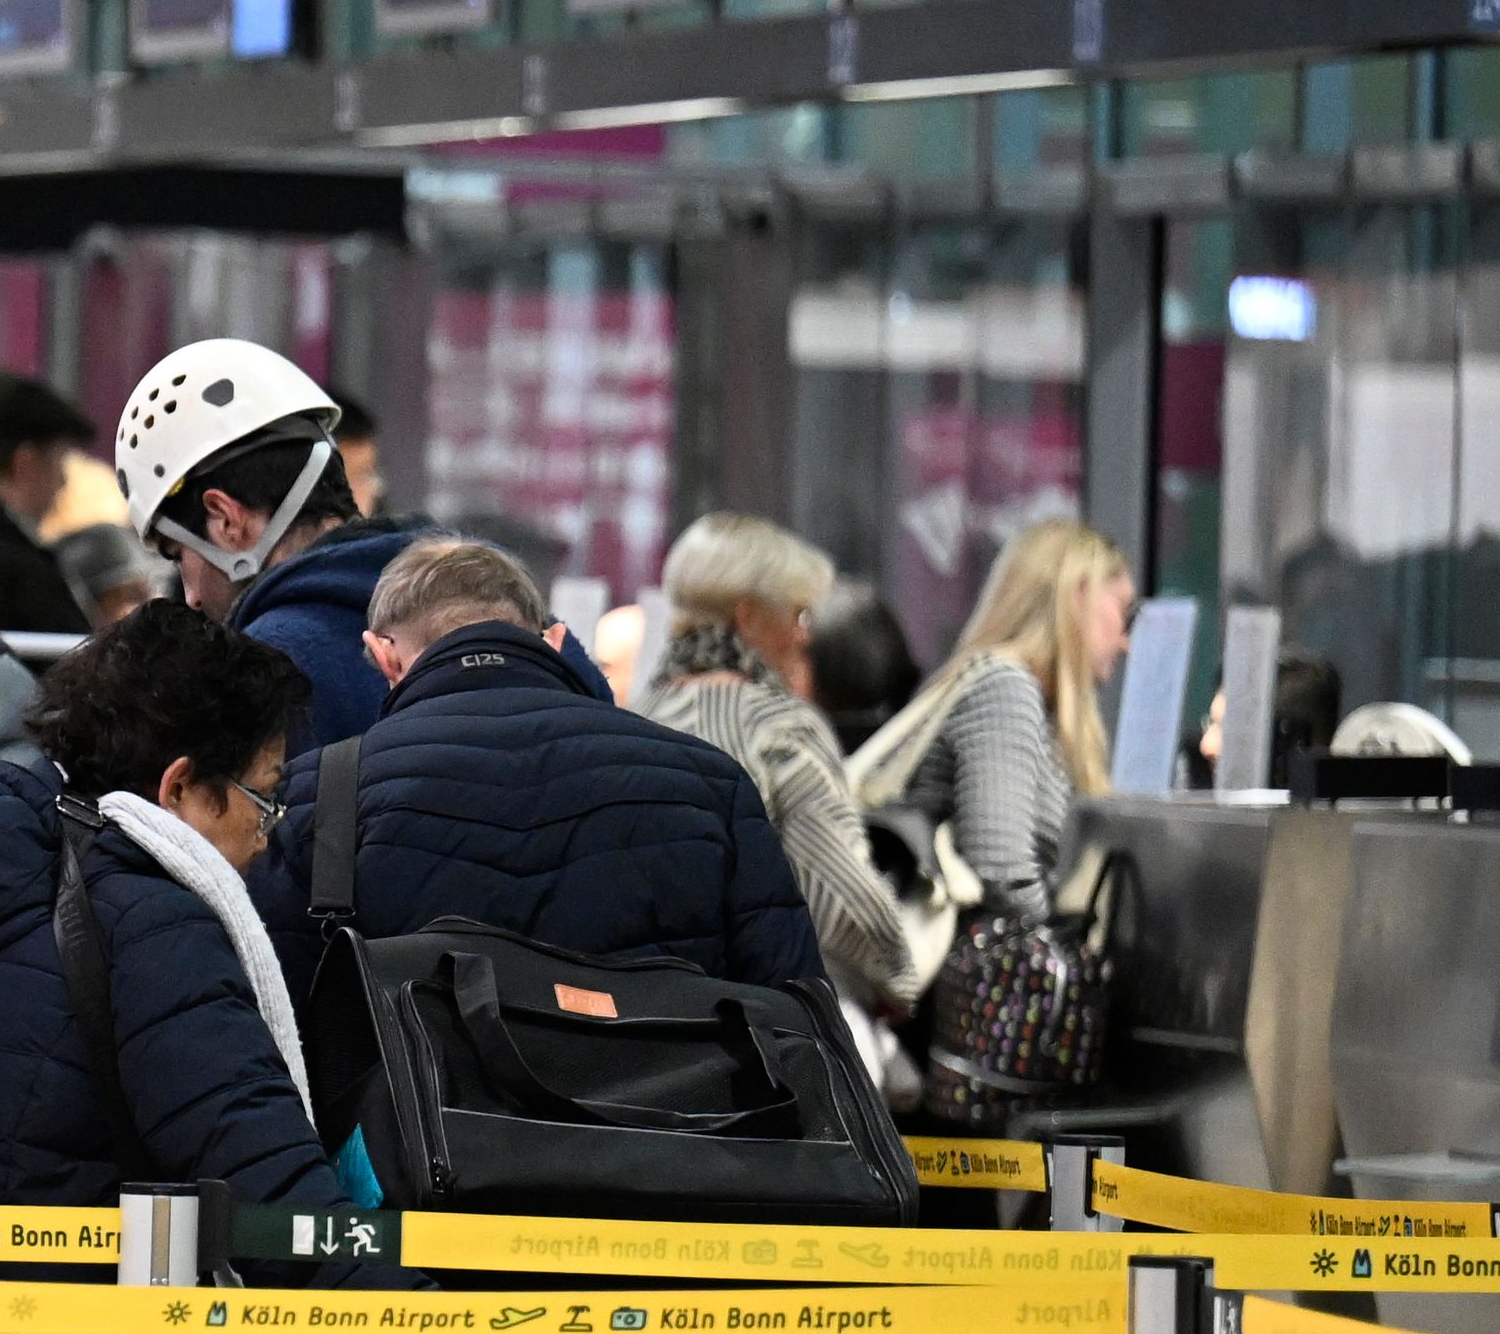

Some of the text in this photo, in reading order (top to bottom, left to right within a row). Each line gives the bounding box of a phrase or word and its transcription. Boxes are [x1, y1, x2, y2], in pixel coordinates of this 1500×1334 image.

[10, 1224, 68, 1248] Bonn
[1384, 1253, 1436, 1277] Köln
[239, 1305, 476, 1333] Köln Bonn Airport
[659, 1305, 893, 1334] Köln Bonn Airport
